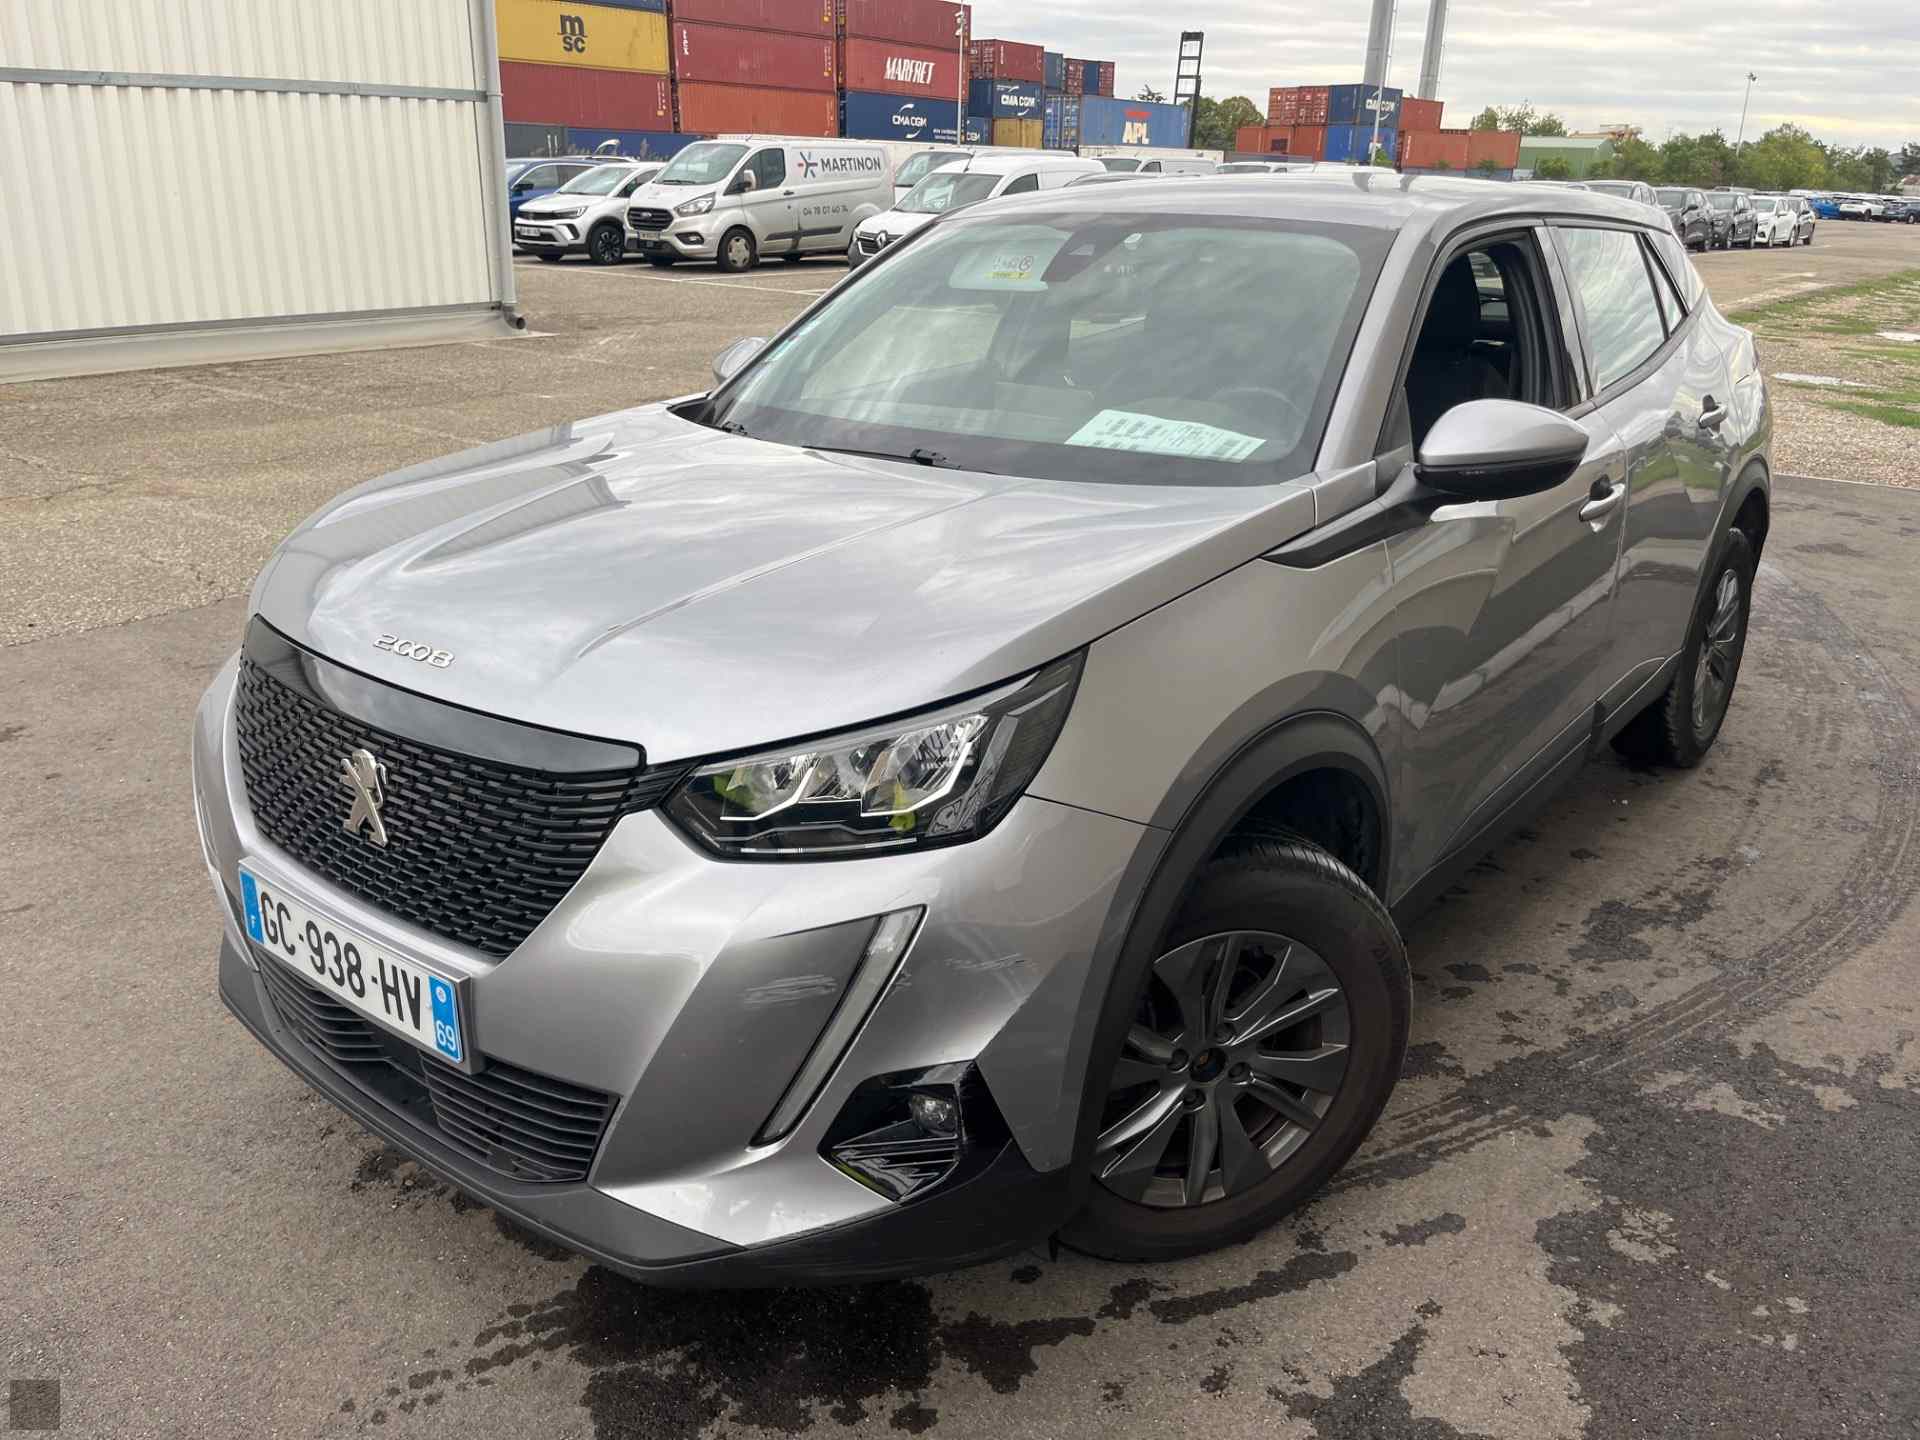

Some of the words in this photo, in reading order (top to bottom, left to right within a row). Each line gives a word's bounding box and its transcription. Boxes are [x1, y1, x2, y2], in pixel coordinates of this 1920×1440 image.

[883, 56, 936, 85] MARFRET
[892, 115, 910, 125] CMA
[910, 116, 928, 127] CGM
[820, 157, 881, 172] MARTINON
[373, 633, 455, 669] 2008
[261, 891, 421, 1031] GC-938-HV
[436, 1020, 456, 1050] 69
